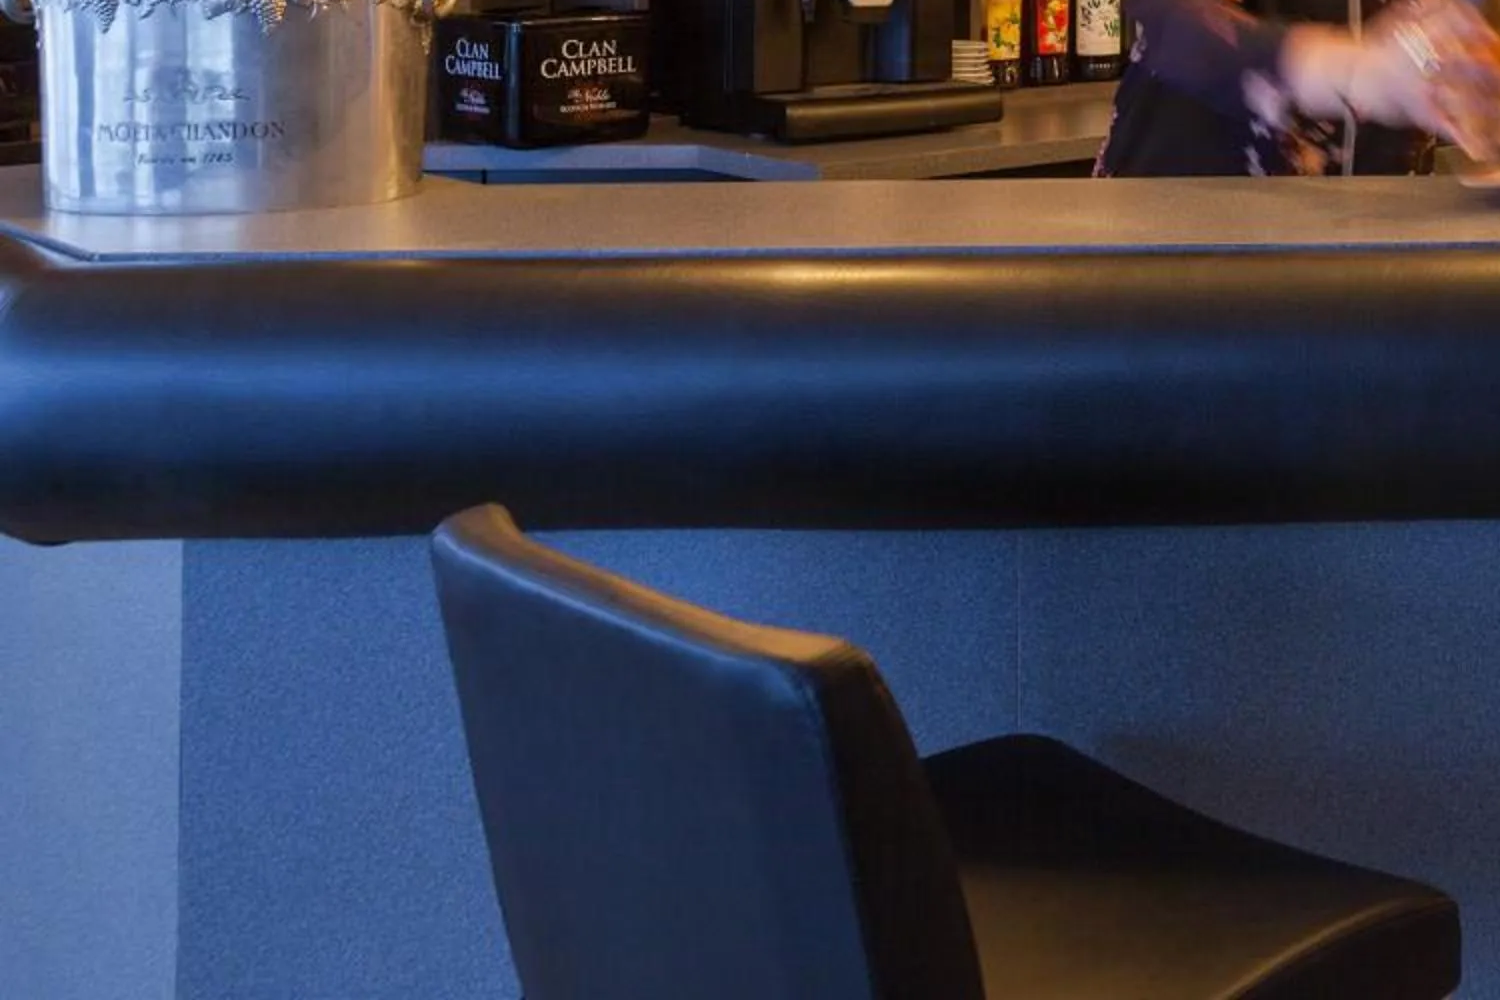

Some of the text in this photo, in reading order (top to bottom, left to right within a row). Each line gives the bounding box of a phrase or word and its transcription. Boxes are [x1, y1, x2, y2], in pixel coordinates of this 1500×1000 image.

[456, 38, 489, 58] CLAN
[561, 39, 617, 60] CLAN
[445, 54, 502, 81] CAMPBELL
[540, 56, 636, 79] CAMPBELL
